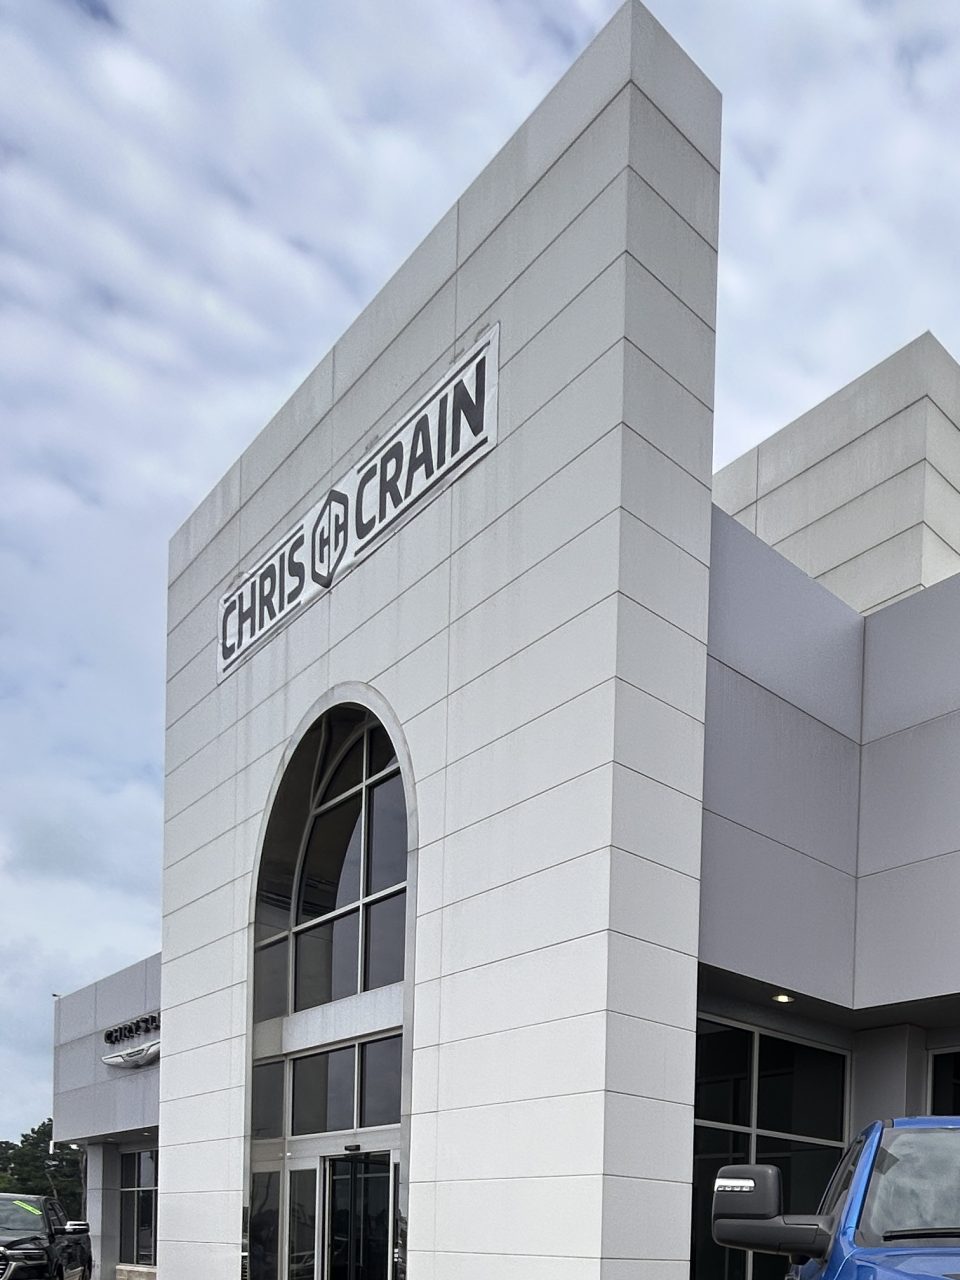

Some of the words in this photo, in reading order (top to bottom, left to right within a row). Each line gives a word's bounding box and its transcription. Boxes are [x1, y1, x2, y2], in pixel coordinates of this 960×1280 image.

[222, 534, 305, 661] CHRIS
[355, 356, 487, 541] CRAIN
[104, 1011, 161, 1044] CHRYSL
